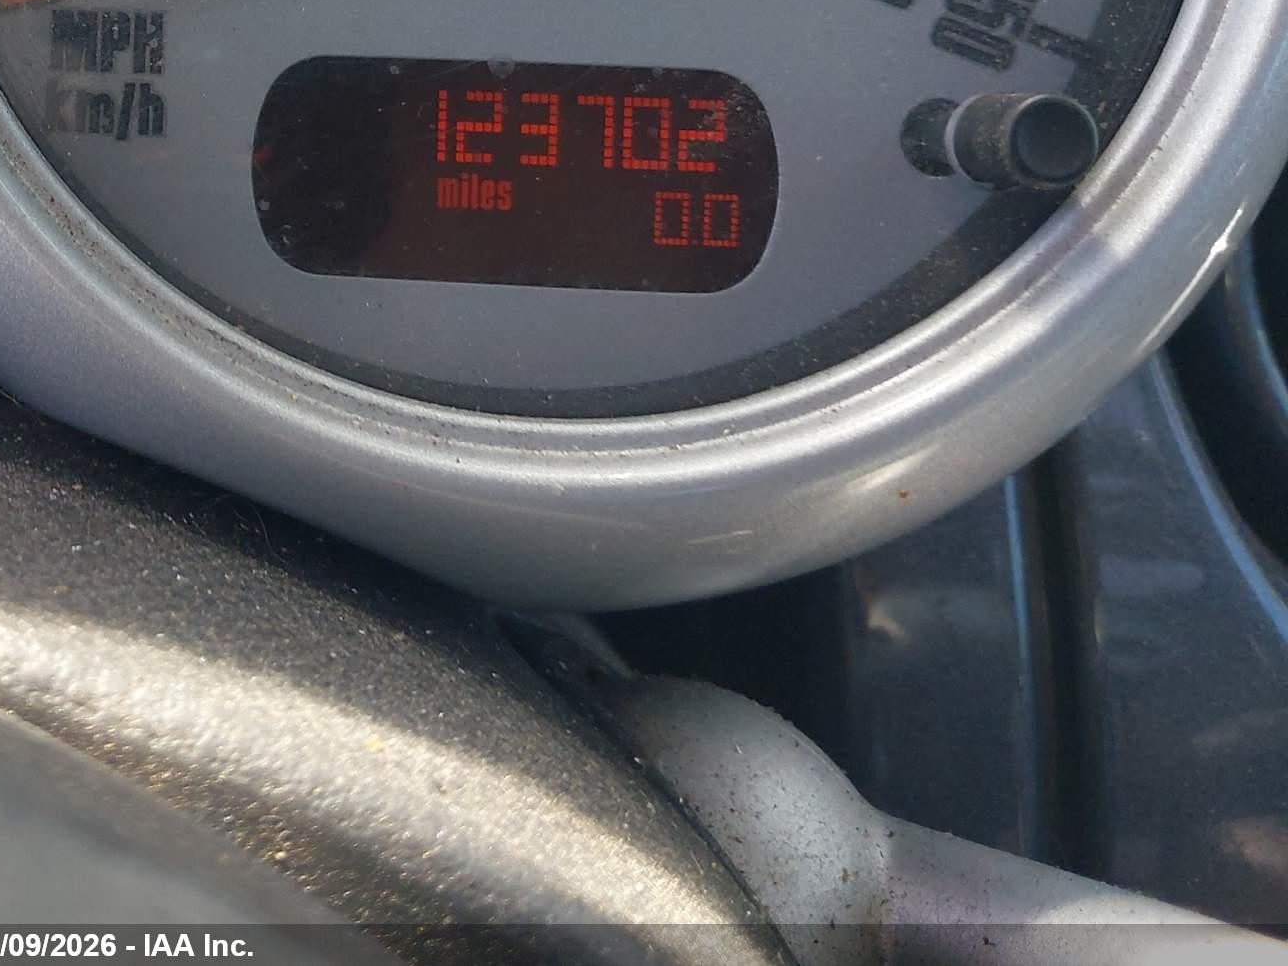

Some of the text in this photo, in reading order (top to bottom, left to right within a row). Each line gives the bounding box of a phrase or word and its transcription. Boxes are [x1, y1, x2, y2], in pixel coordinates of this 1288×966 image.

[49, 9, 164, 74] MPH
[436, 89, 726, 172] 123702
[437, 174, 512, 211] miles
